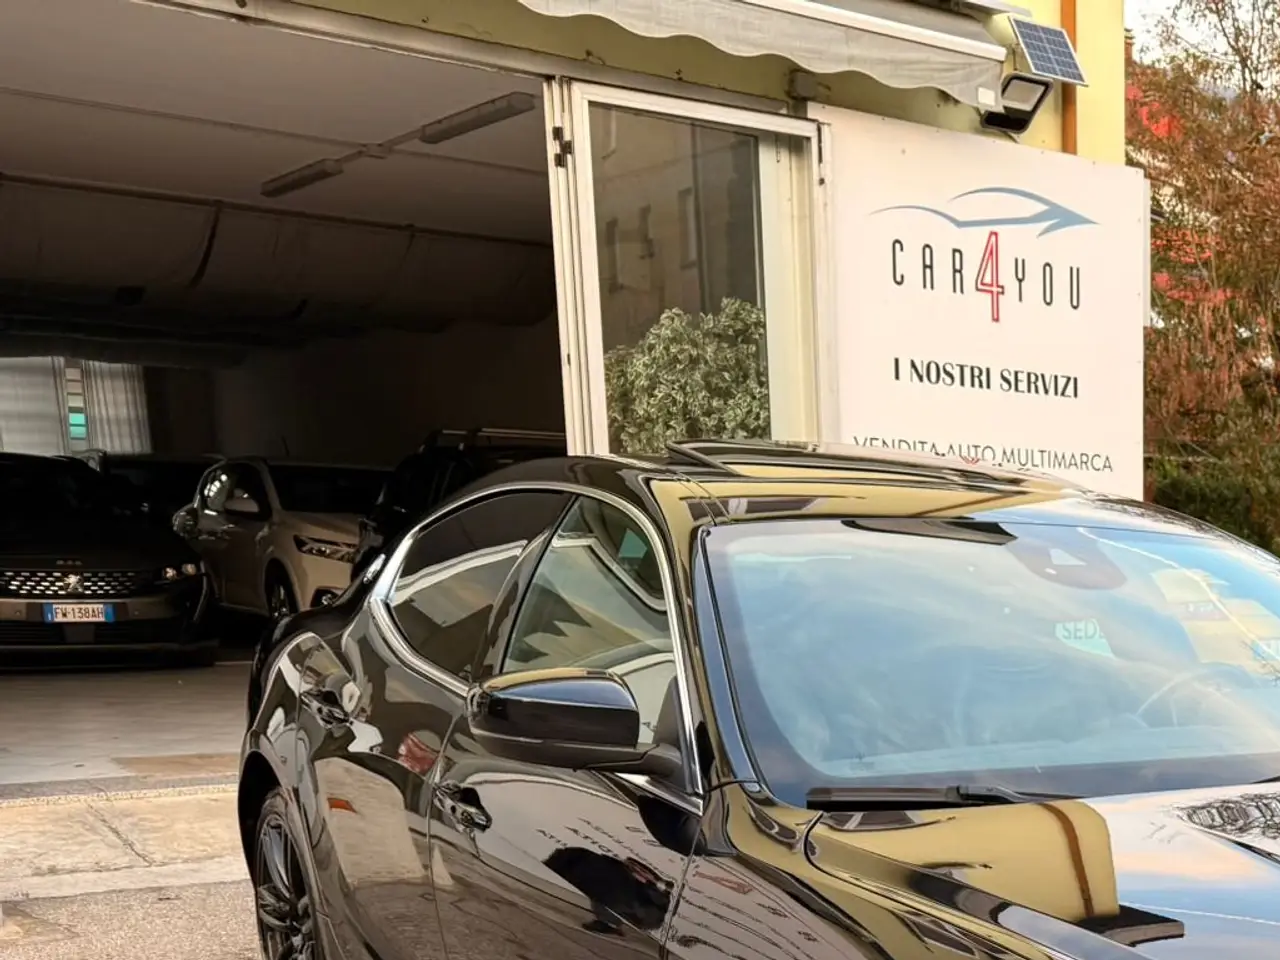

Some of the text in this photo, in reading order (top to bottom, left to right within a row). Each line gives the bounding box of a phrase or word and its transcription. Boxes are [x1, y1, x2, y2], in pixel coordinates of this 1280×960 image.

[894, 357, 1079, 399] I NOSTRI SERVIZI
[1001, 447, 1114, 473] MULTIMARCA
